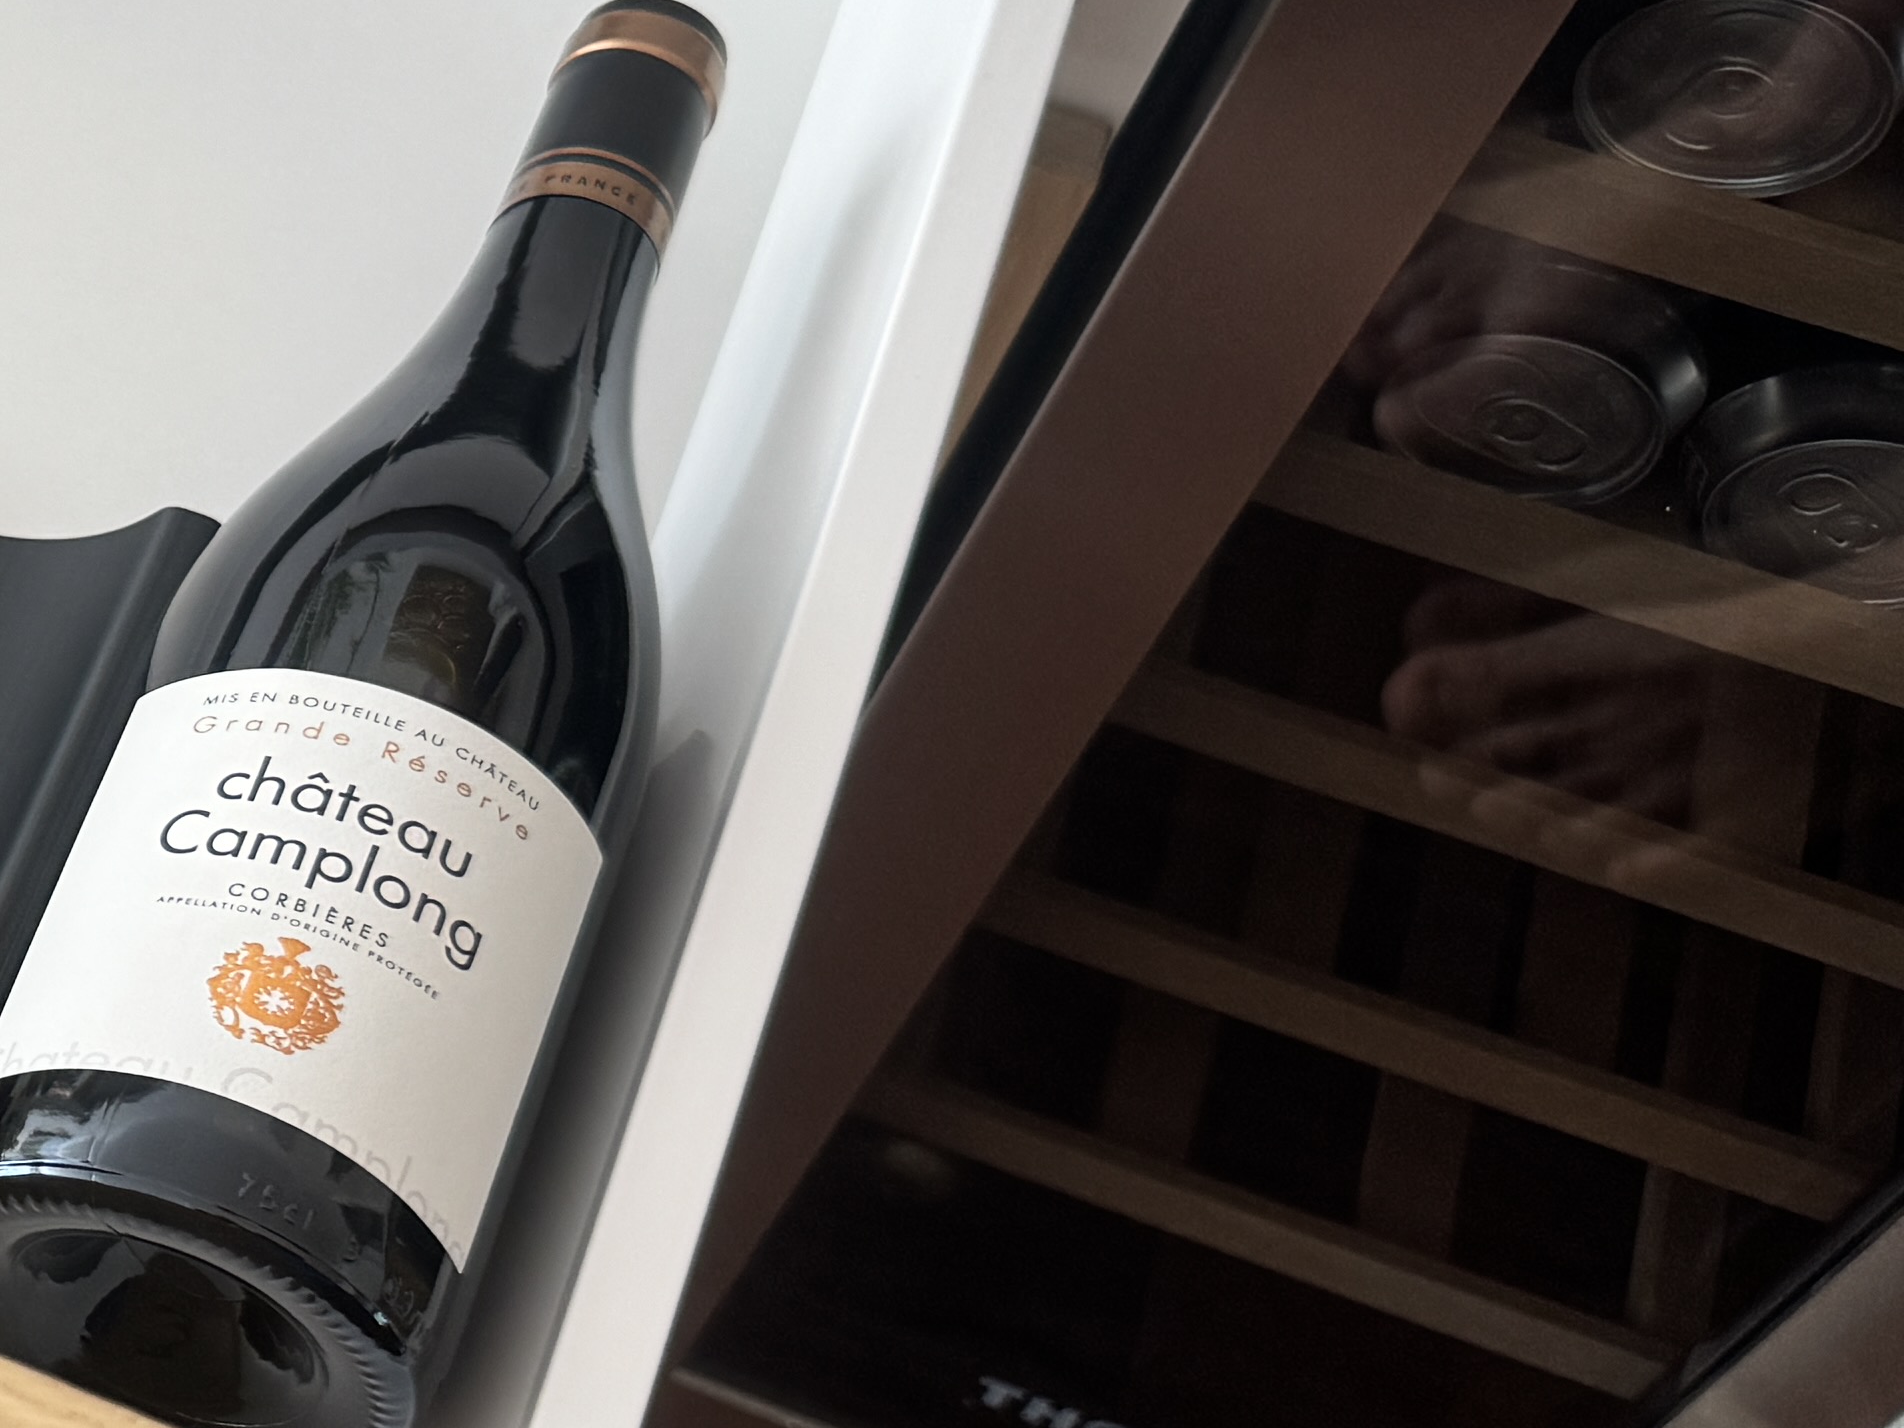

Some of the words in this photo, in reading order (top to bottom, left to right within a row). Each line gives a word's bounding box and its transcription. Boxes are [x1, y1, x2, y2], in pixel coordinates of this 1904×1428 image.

[544, 174, 641, 206] FRANCE
[193, 715, 350, 746] Grande
[381, 740, 529, 841] Réserve
[203, 692, 239, 706] MIS
[250, 691, 277, 703] EN
[288, 693, 407, 732] BOUTEILLE
[414, 728, 445, 748] AU
[455, 746, 540, 811] CHÂTEAU
[216, 755, 474, 879] château
[156, 895, 261, 916] APPELLATION
[270, 912, 360, 952] D'ORIGINE
[158, 809, 484, 971] Camplong
[228, 882, 391, 949] CORBIÈRES
